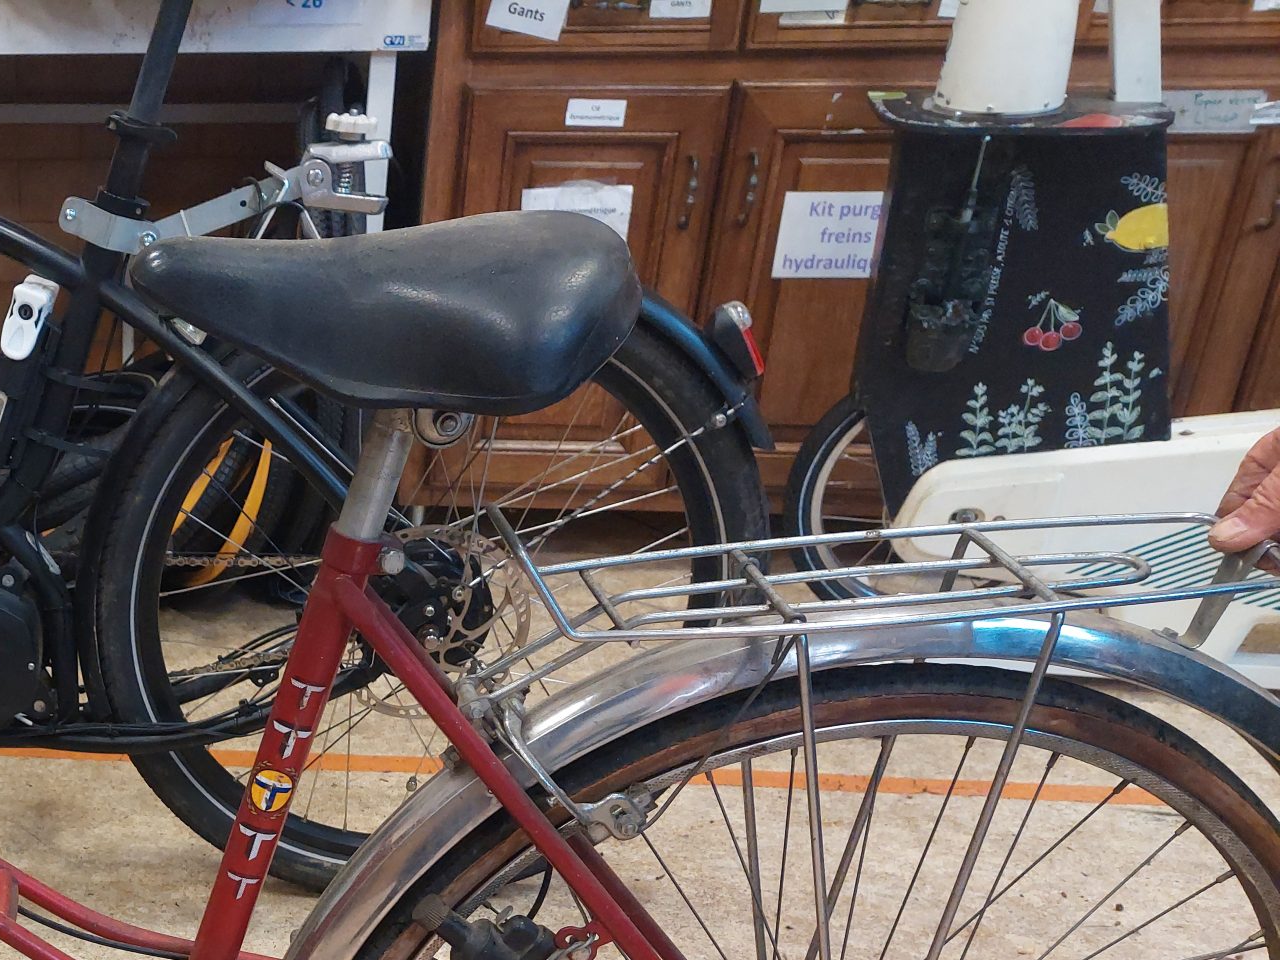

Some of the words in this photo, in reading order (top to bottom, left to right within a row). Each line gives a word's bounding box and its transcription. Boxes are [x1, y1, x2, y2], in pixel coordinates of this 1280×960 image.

[508, 1, 546, 22] Gants
[809, 201, 835, 217] Kit
[839, 204, 881, 221] purg
[820, 227, 872, 244] freins
[782, 253, 871, 273] hydrauliq
